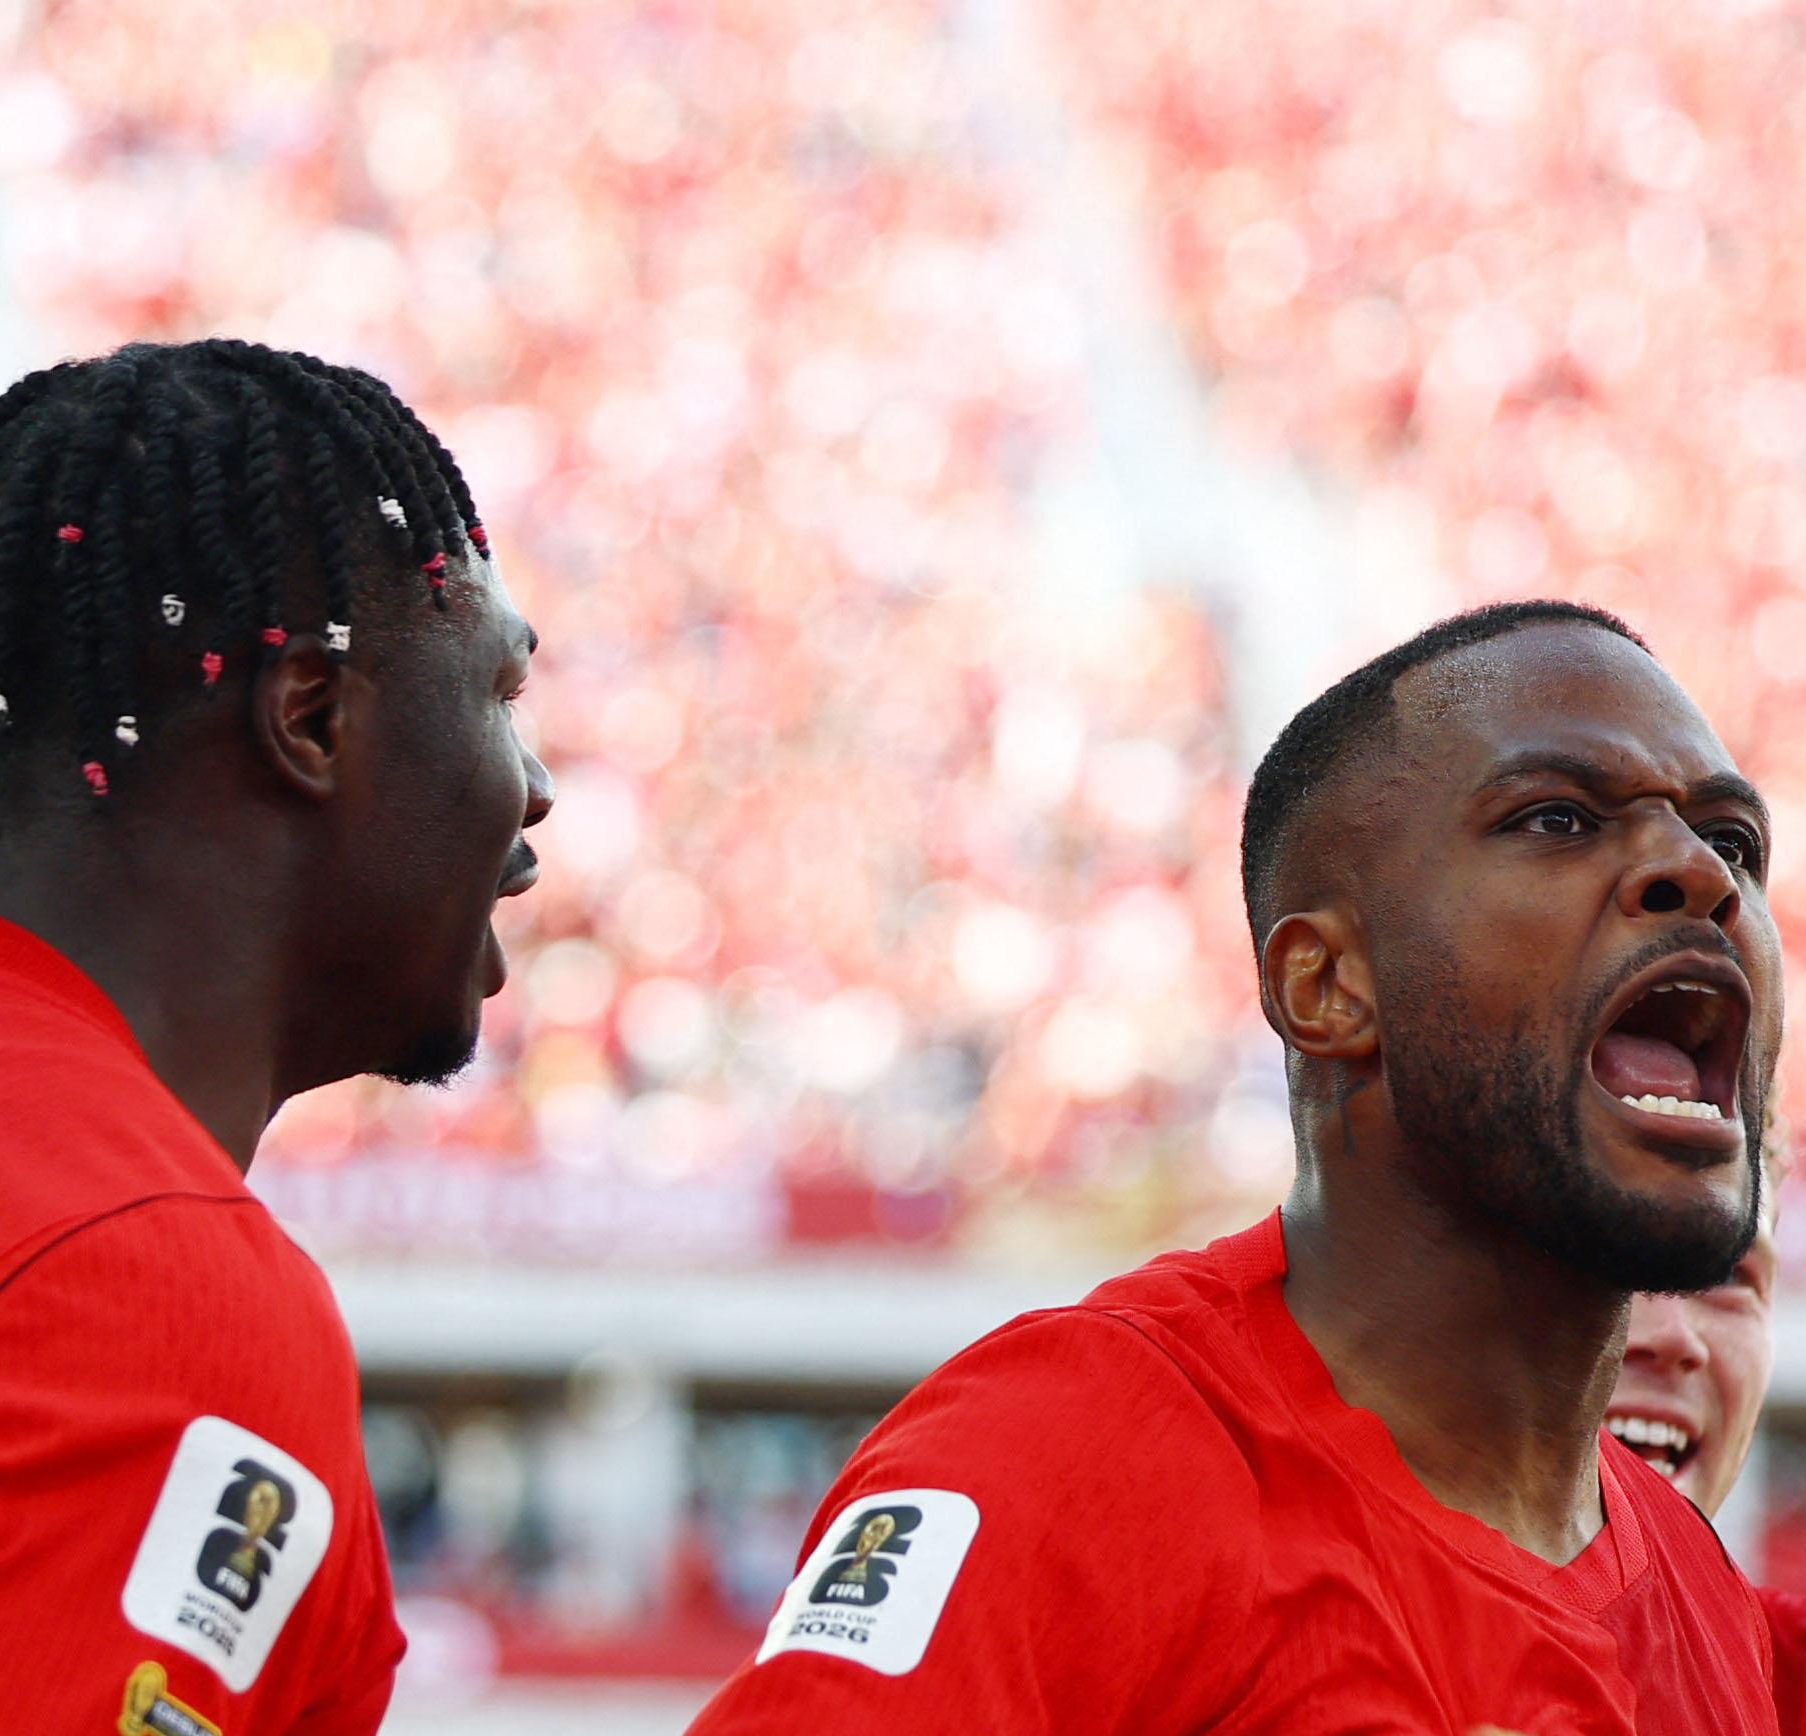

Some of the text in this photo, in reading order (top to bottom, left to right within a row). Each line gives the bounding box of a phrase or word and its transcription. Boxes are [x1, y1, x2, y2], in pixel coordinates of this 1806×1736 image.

[826, 1583, 866, 1600] FIFA
[847, 1611, 878, 1625] CUP
[789, 1620, 870, 1645] 2026
